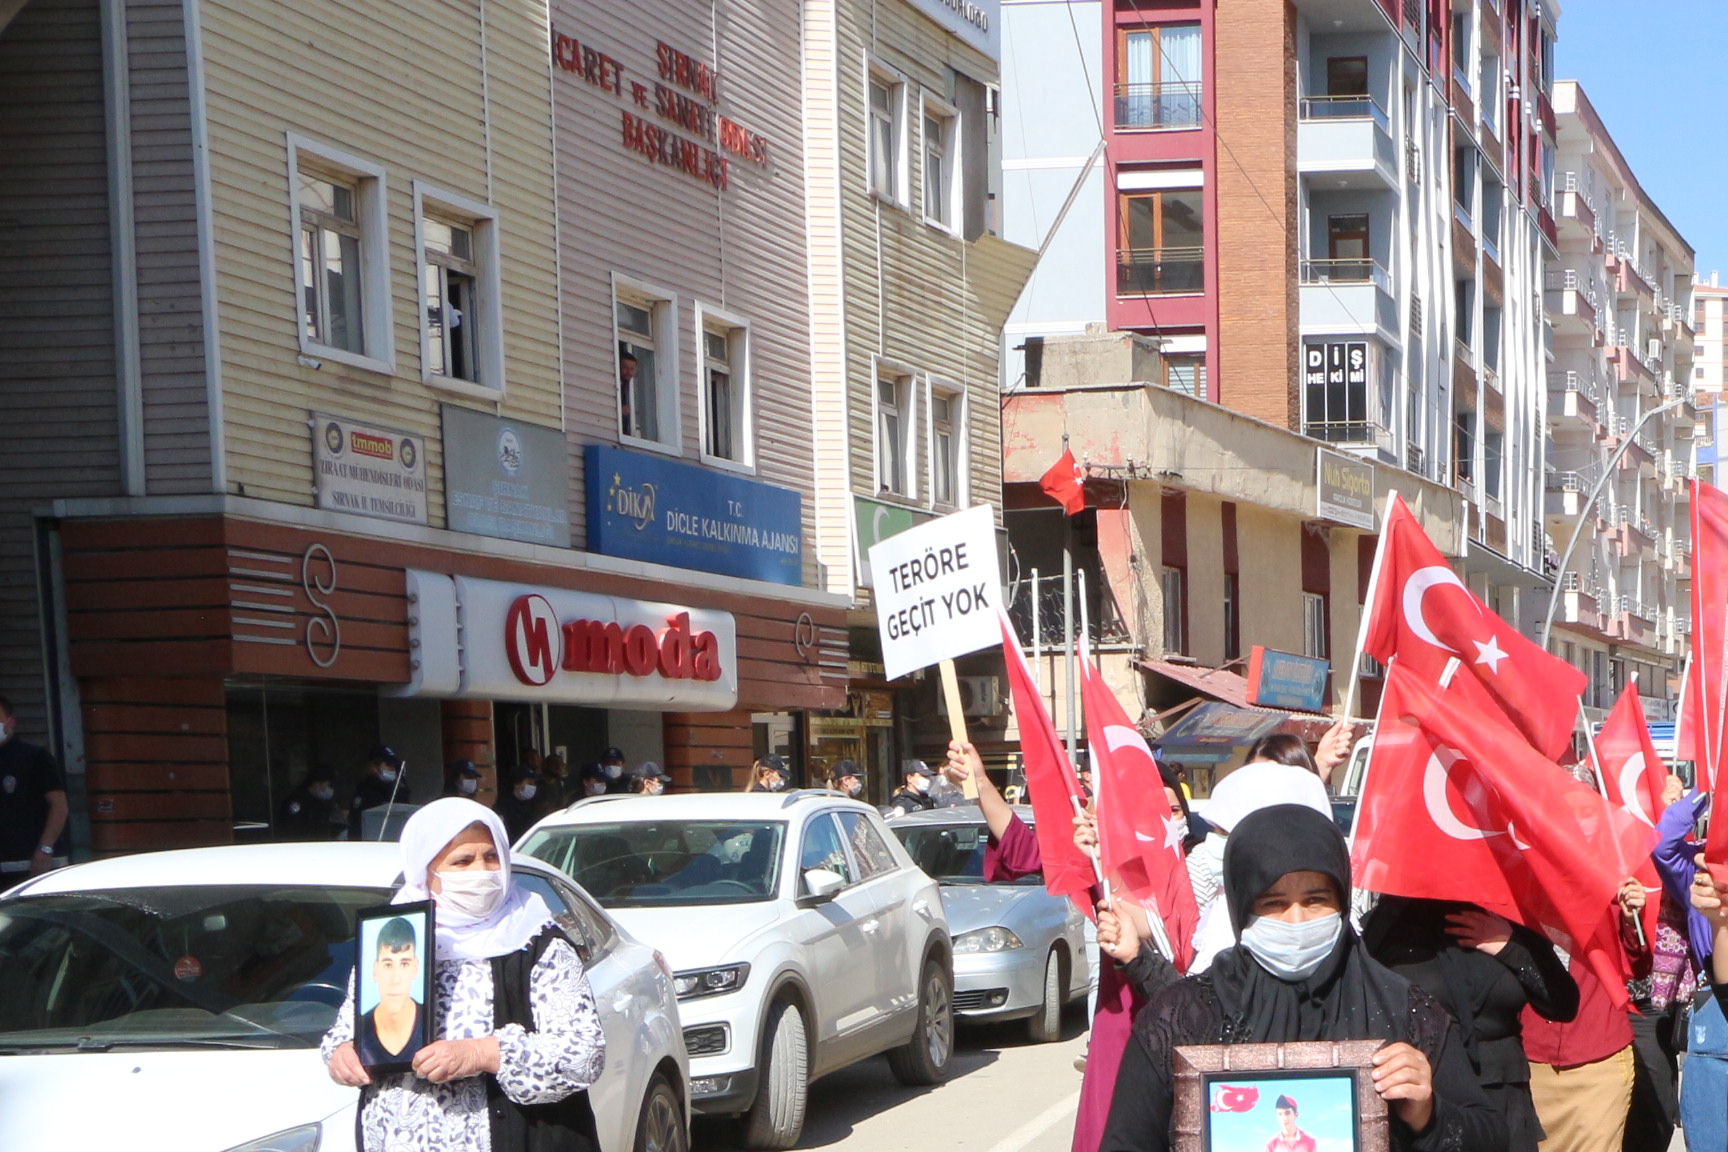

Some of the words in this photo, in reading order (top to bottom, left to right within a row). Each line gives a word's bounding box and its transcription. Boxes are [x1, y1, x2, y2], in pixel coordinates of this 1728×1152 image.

[550, 22, 624, 97] İCARET
[351, 434, 392, 455] tmmob
[666, 507, 698, 536] DİCLE
[701, 518, 760, 548] KALKINMA
[761, 529, 799, 555] AJANSI
[889, 541, 970, 595] TERÖRE
[887, 595, 937, 642] GEÇİT
[941, 581, 990, 621] YOK
[562, 611, 722, 681] moda
